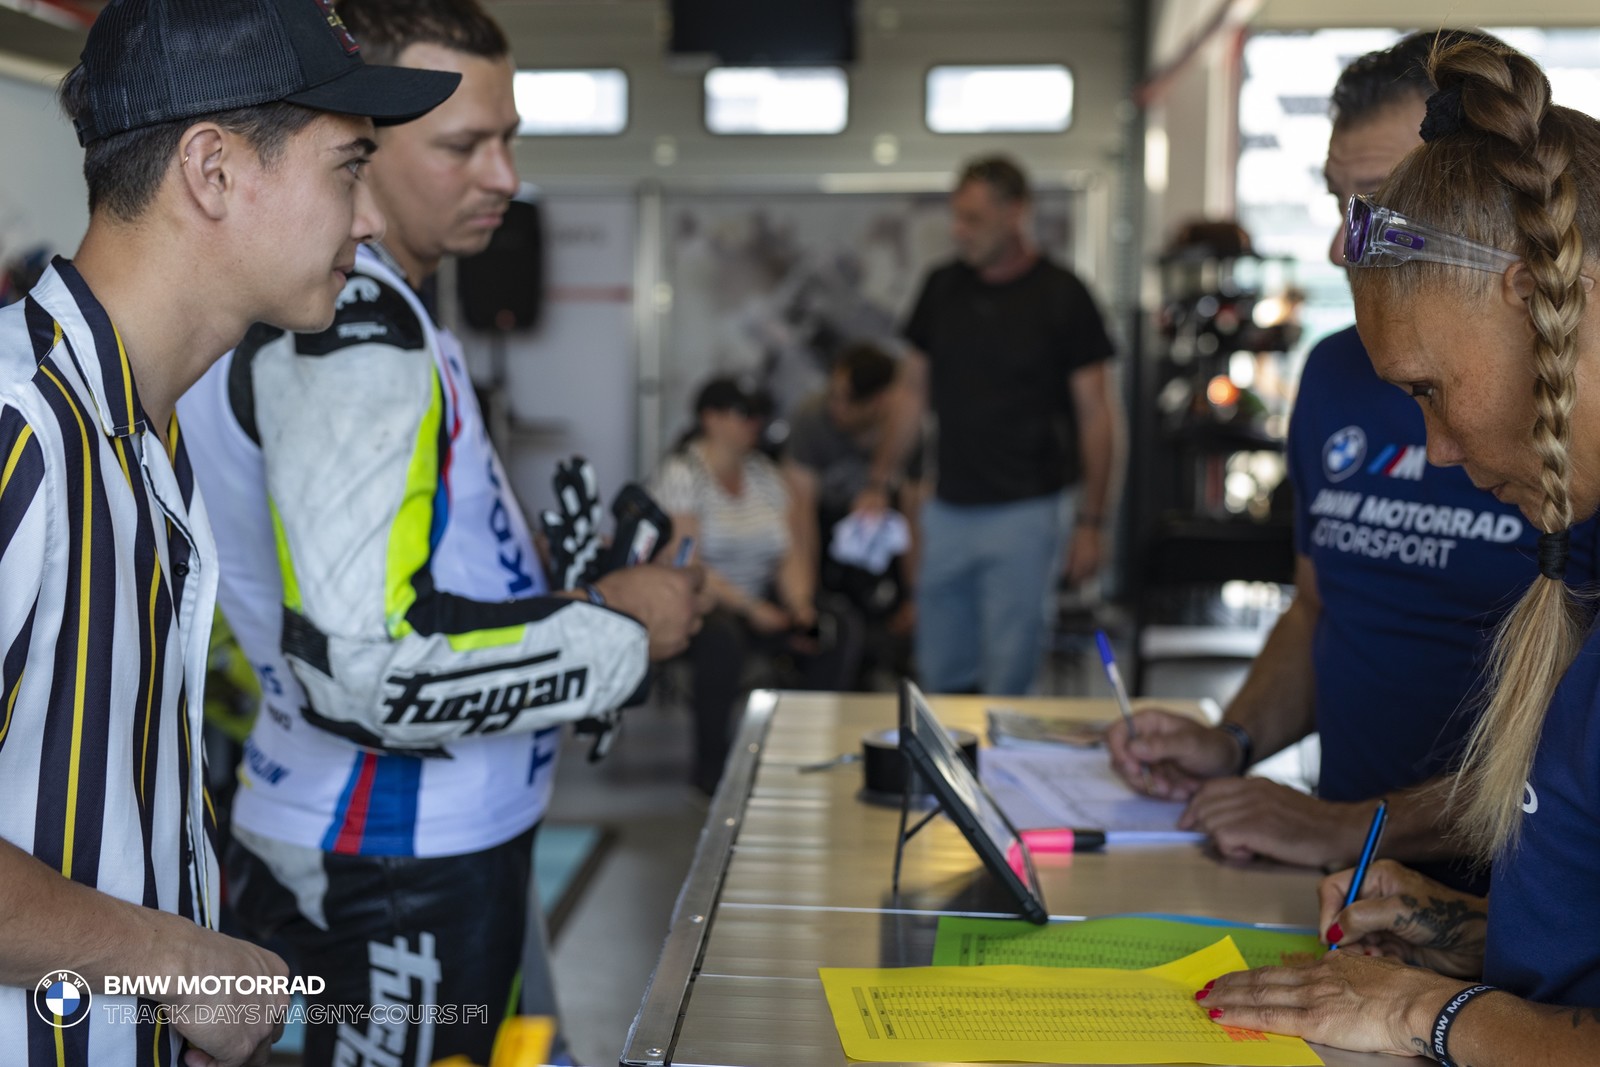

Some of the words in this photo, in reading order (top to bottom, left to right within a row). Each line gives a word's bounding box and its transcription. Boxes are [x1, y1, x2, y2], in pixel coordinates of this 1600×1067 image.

[1311, 518, 1456, 569] OTORSPORT
[1359, 495, 1523, 544] MOTORRAD
[1434, 1014, 1449, 1056] BMW
